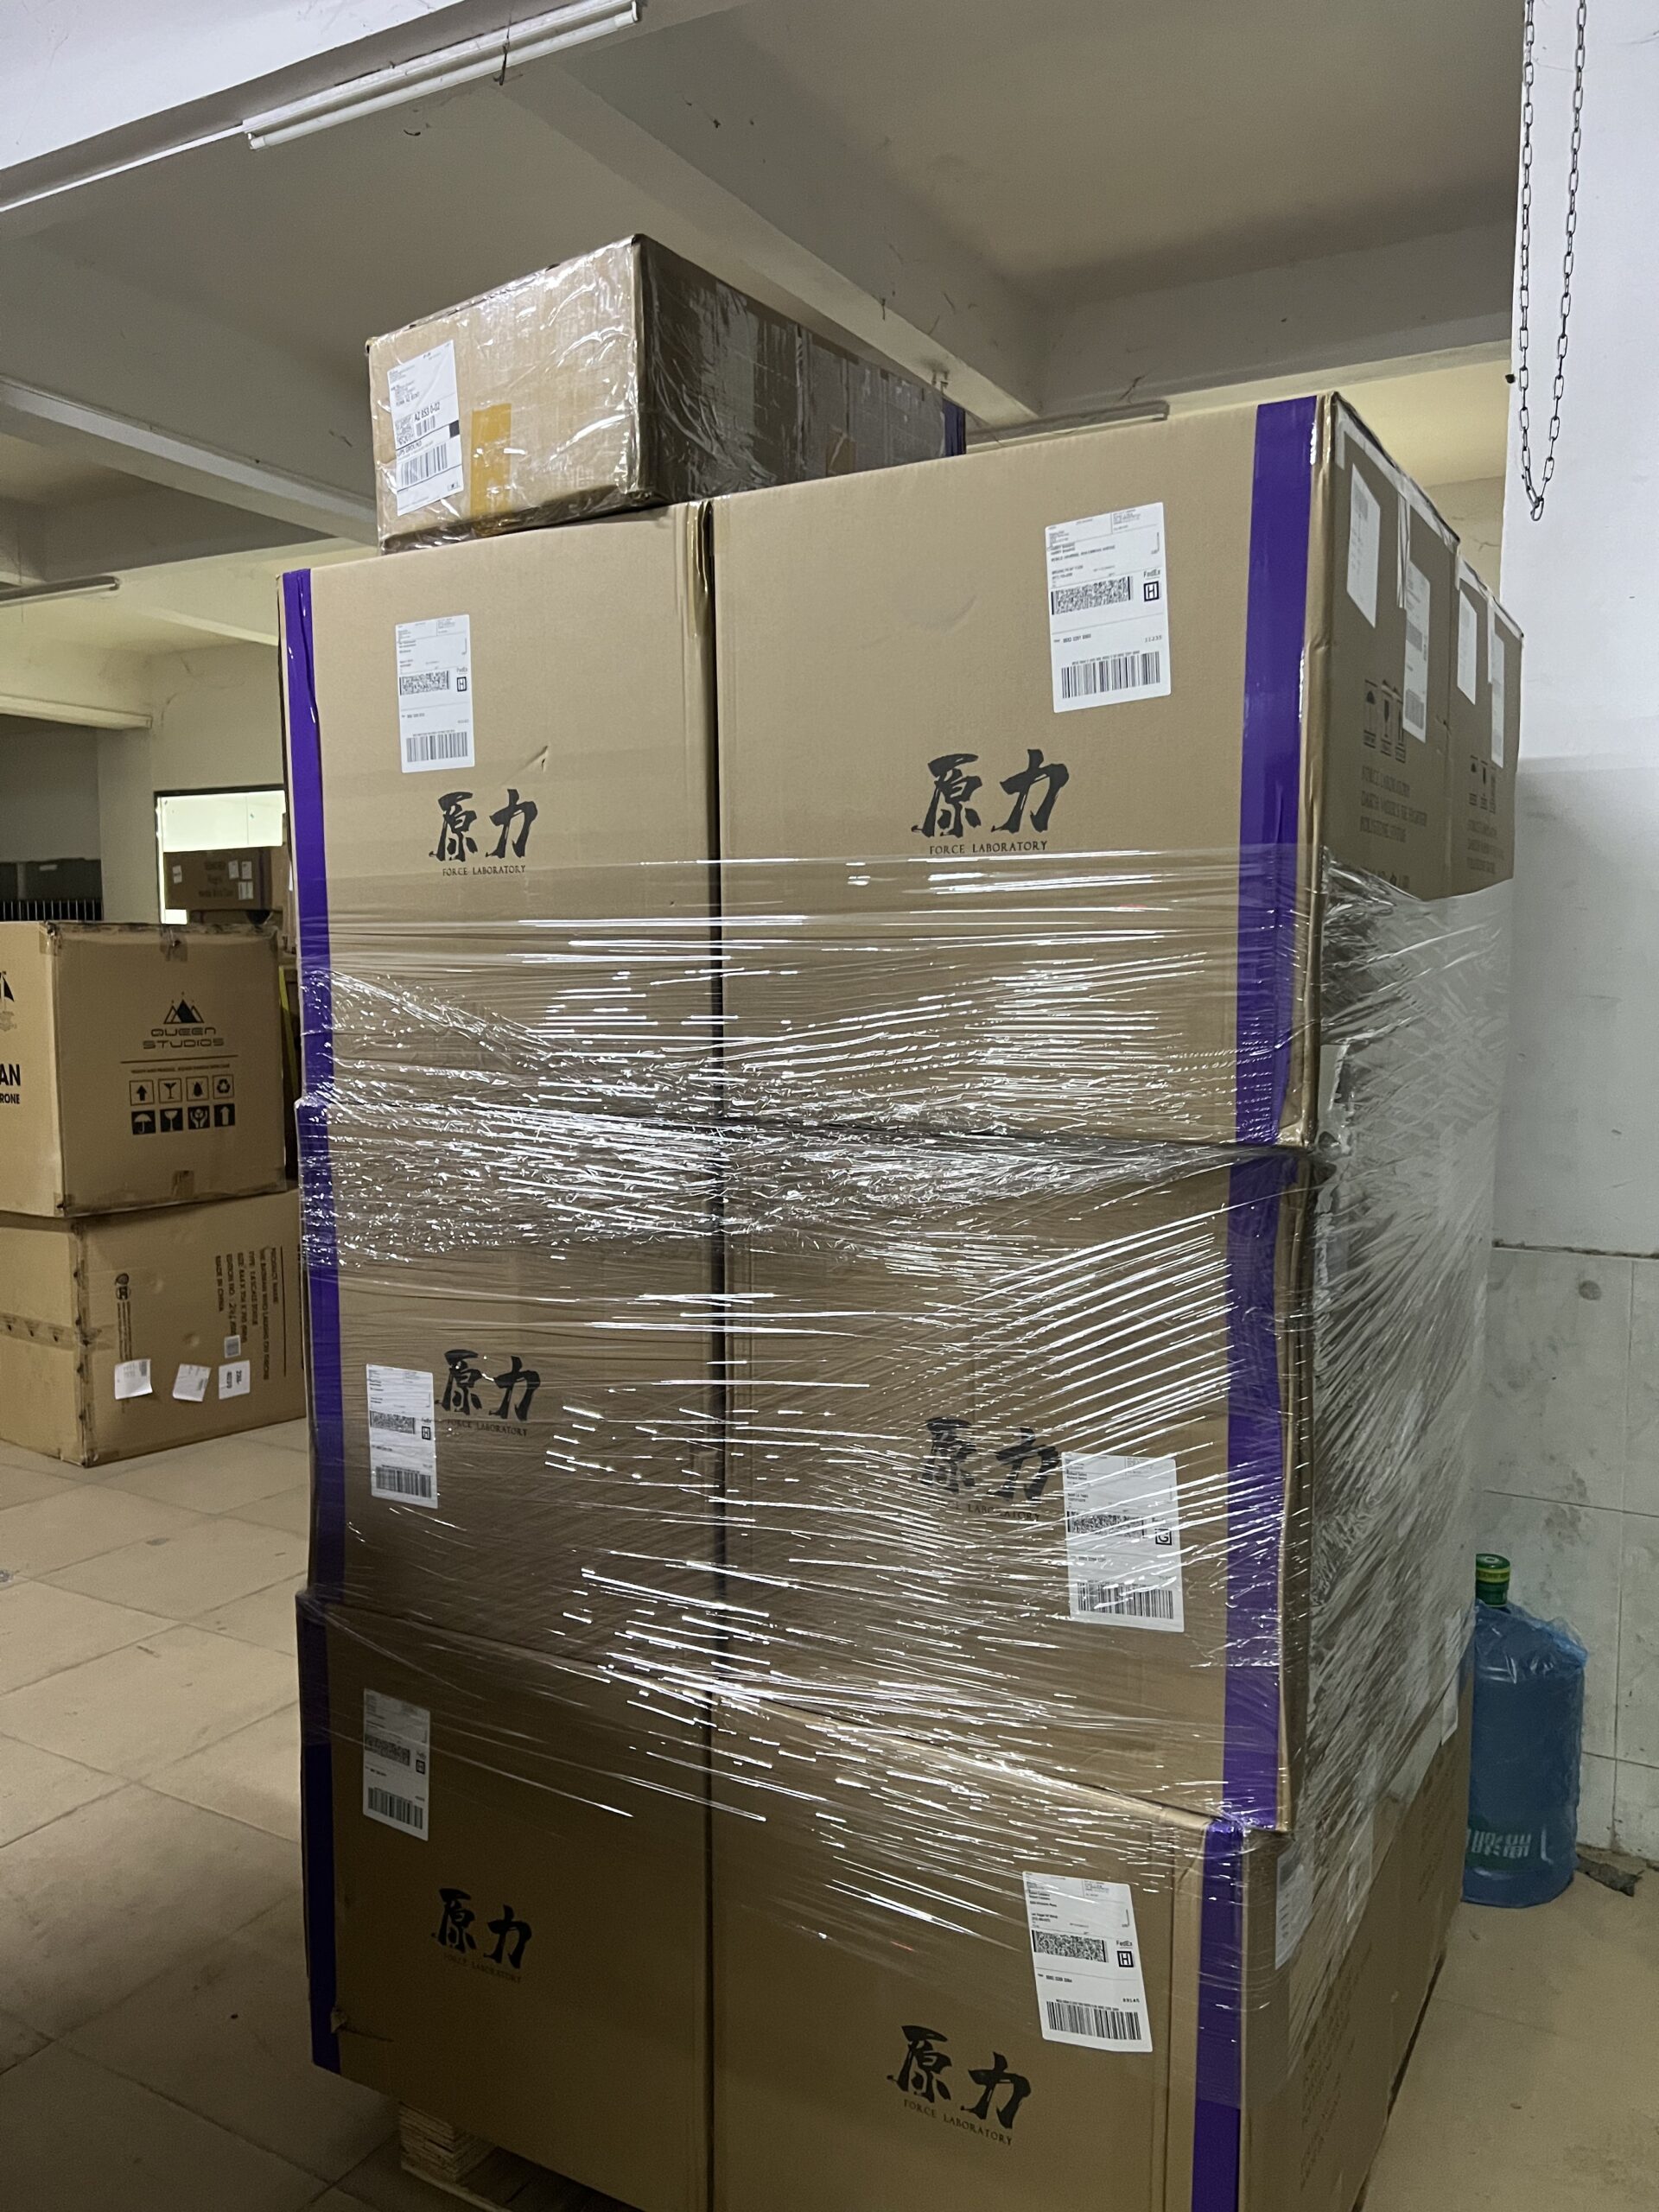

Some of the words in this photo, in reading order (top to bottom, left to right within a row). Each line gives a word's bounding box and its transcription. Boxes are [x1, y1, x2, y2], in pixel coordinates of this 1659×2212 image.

[911, 748, 1070, 838] 原力
[429, 788, 538, 862] 原力
[930, 844, 965, 855] FORCE
[972, 841, 1048, 853] LABORATORY
[442, 867, 467, 877] FORCE
[472, 865, 526, 875] LABORATORY
[143, 1038, 225, 1050] STUDIOS
[150, 1027, 216, 1037] QUEEN
[0, 1064, 21, 1086] AN
[435, 1349, 541, 1421] 原力
[912, 1416, 1060, 1502] 原力
[430, 1887, 532, 1969] 原力
[887, 2024, 1032, 2129] 原力
[904, 2099, 936, 2118] FORCE
[943, 2113, 1013, 2145] LABORATORY
